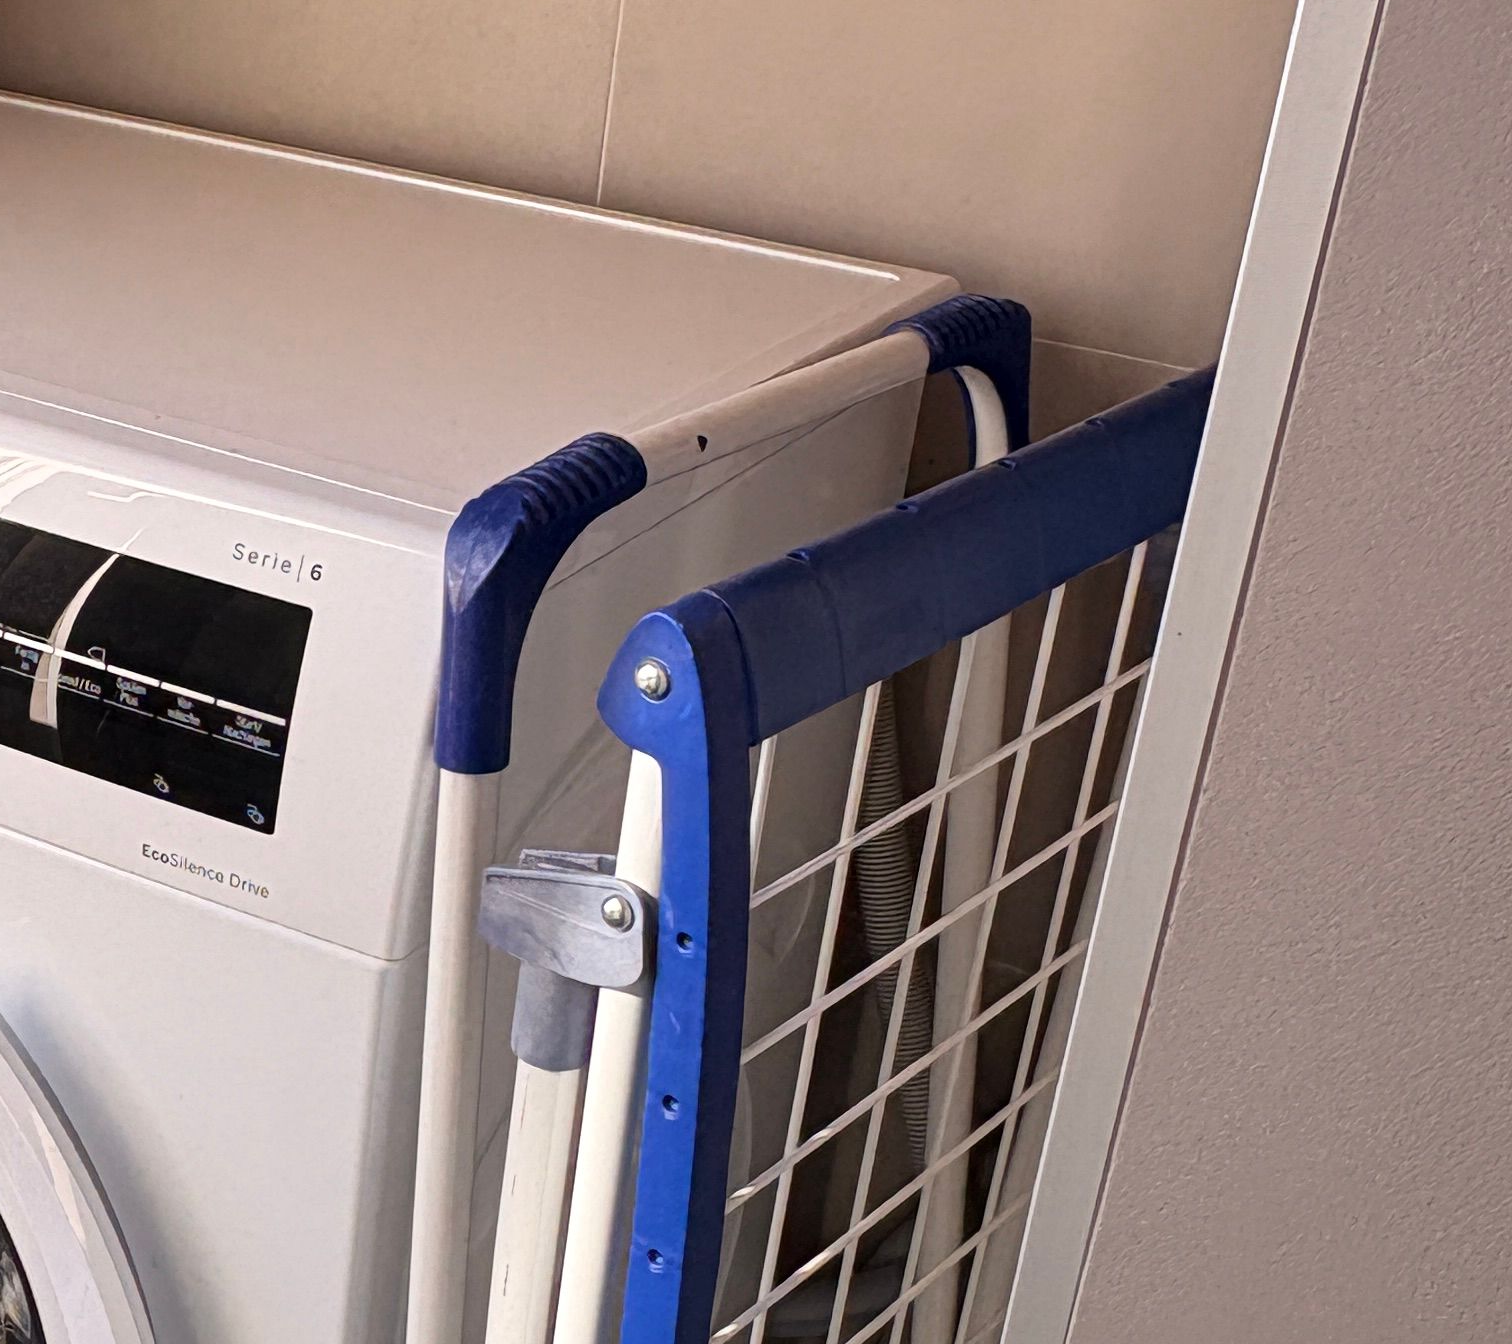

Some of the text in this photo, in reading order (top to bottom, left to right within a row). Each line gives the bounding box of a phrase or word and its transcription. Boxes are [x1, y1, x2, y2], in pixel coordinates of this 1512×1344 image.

[232, 542, 323, 581] Serie 6
[229, 872, 270, 898] Drive
